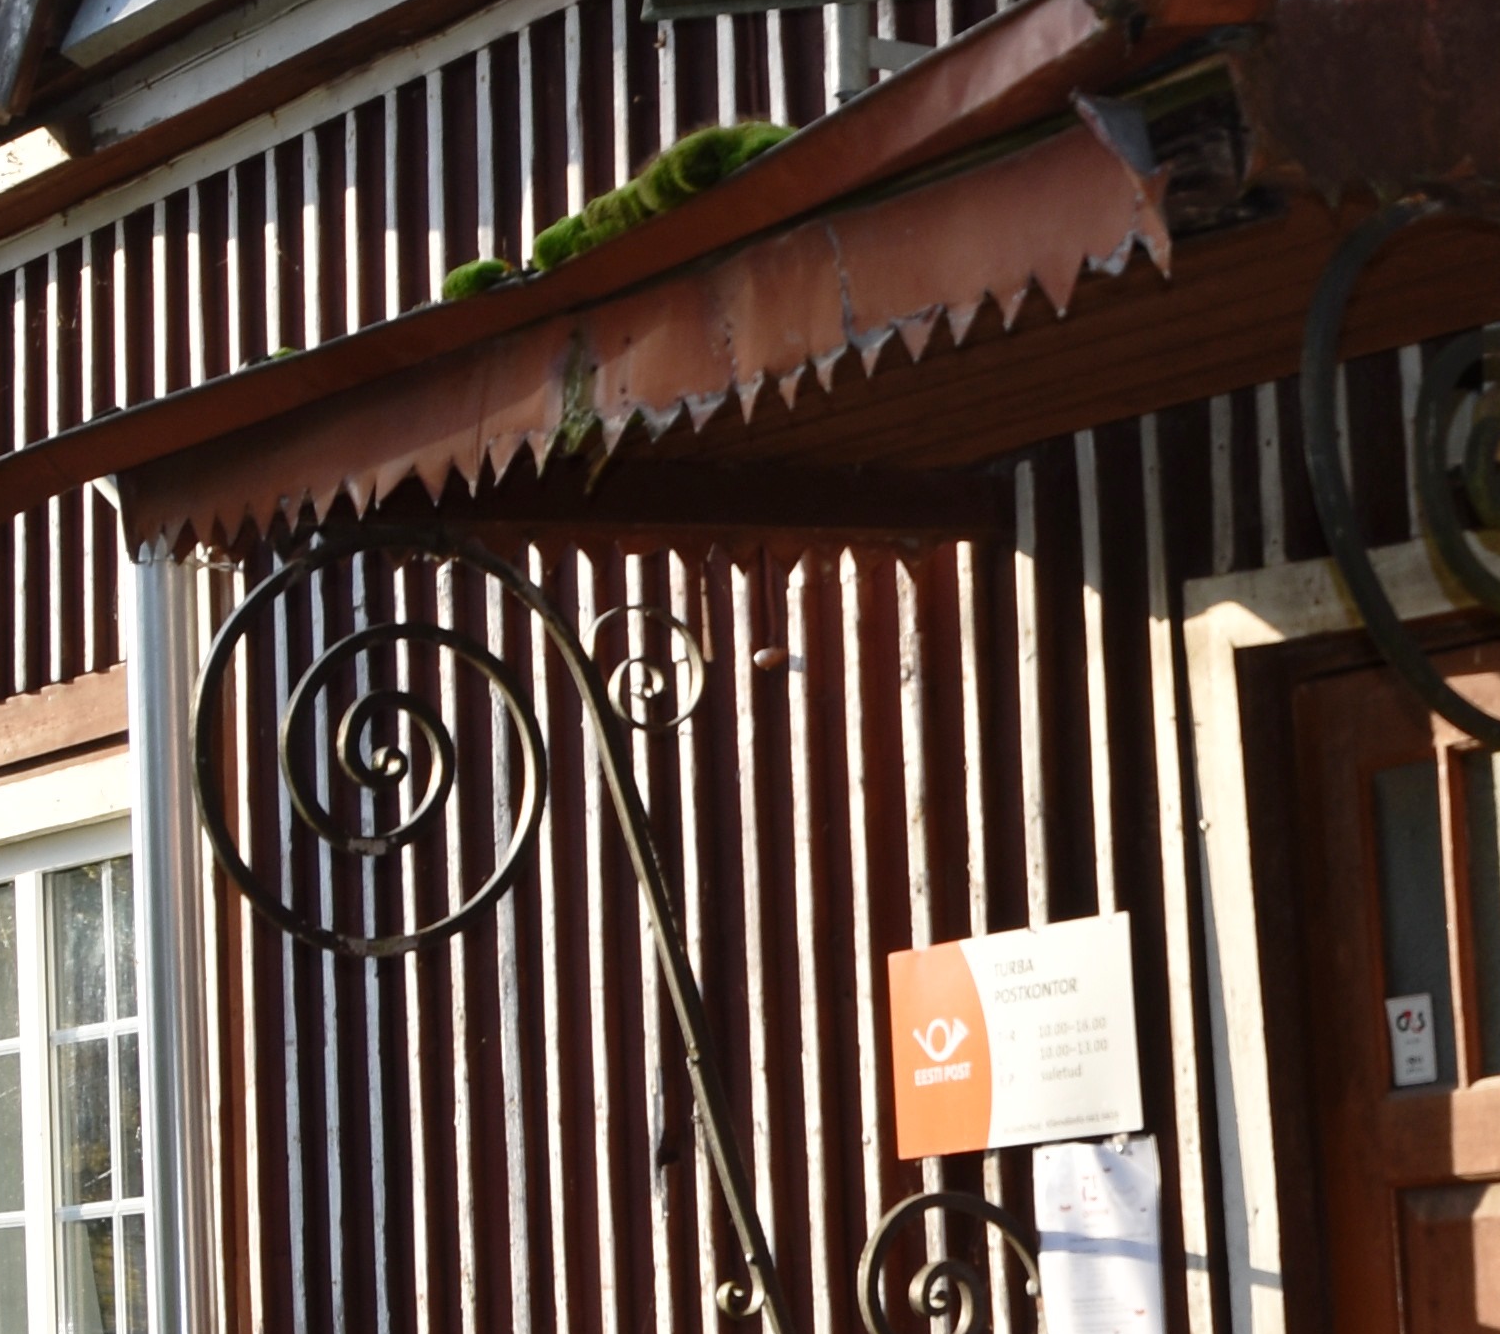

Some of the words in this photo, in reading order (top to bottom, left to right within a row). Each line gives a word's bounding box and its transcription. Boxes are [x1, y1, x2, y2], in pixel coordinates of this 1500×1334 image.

[994, 958, 1034, 977] TURBA
[994, 977, 1078, 1004] POSTKONTOR
[914, 1065, 943, 1086] EESTI
[943, 1061, 972, 1082] POST
